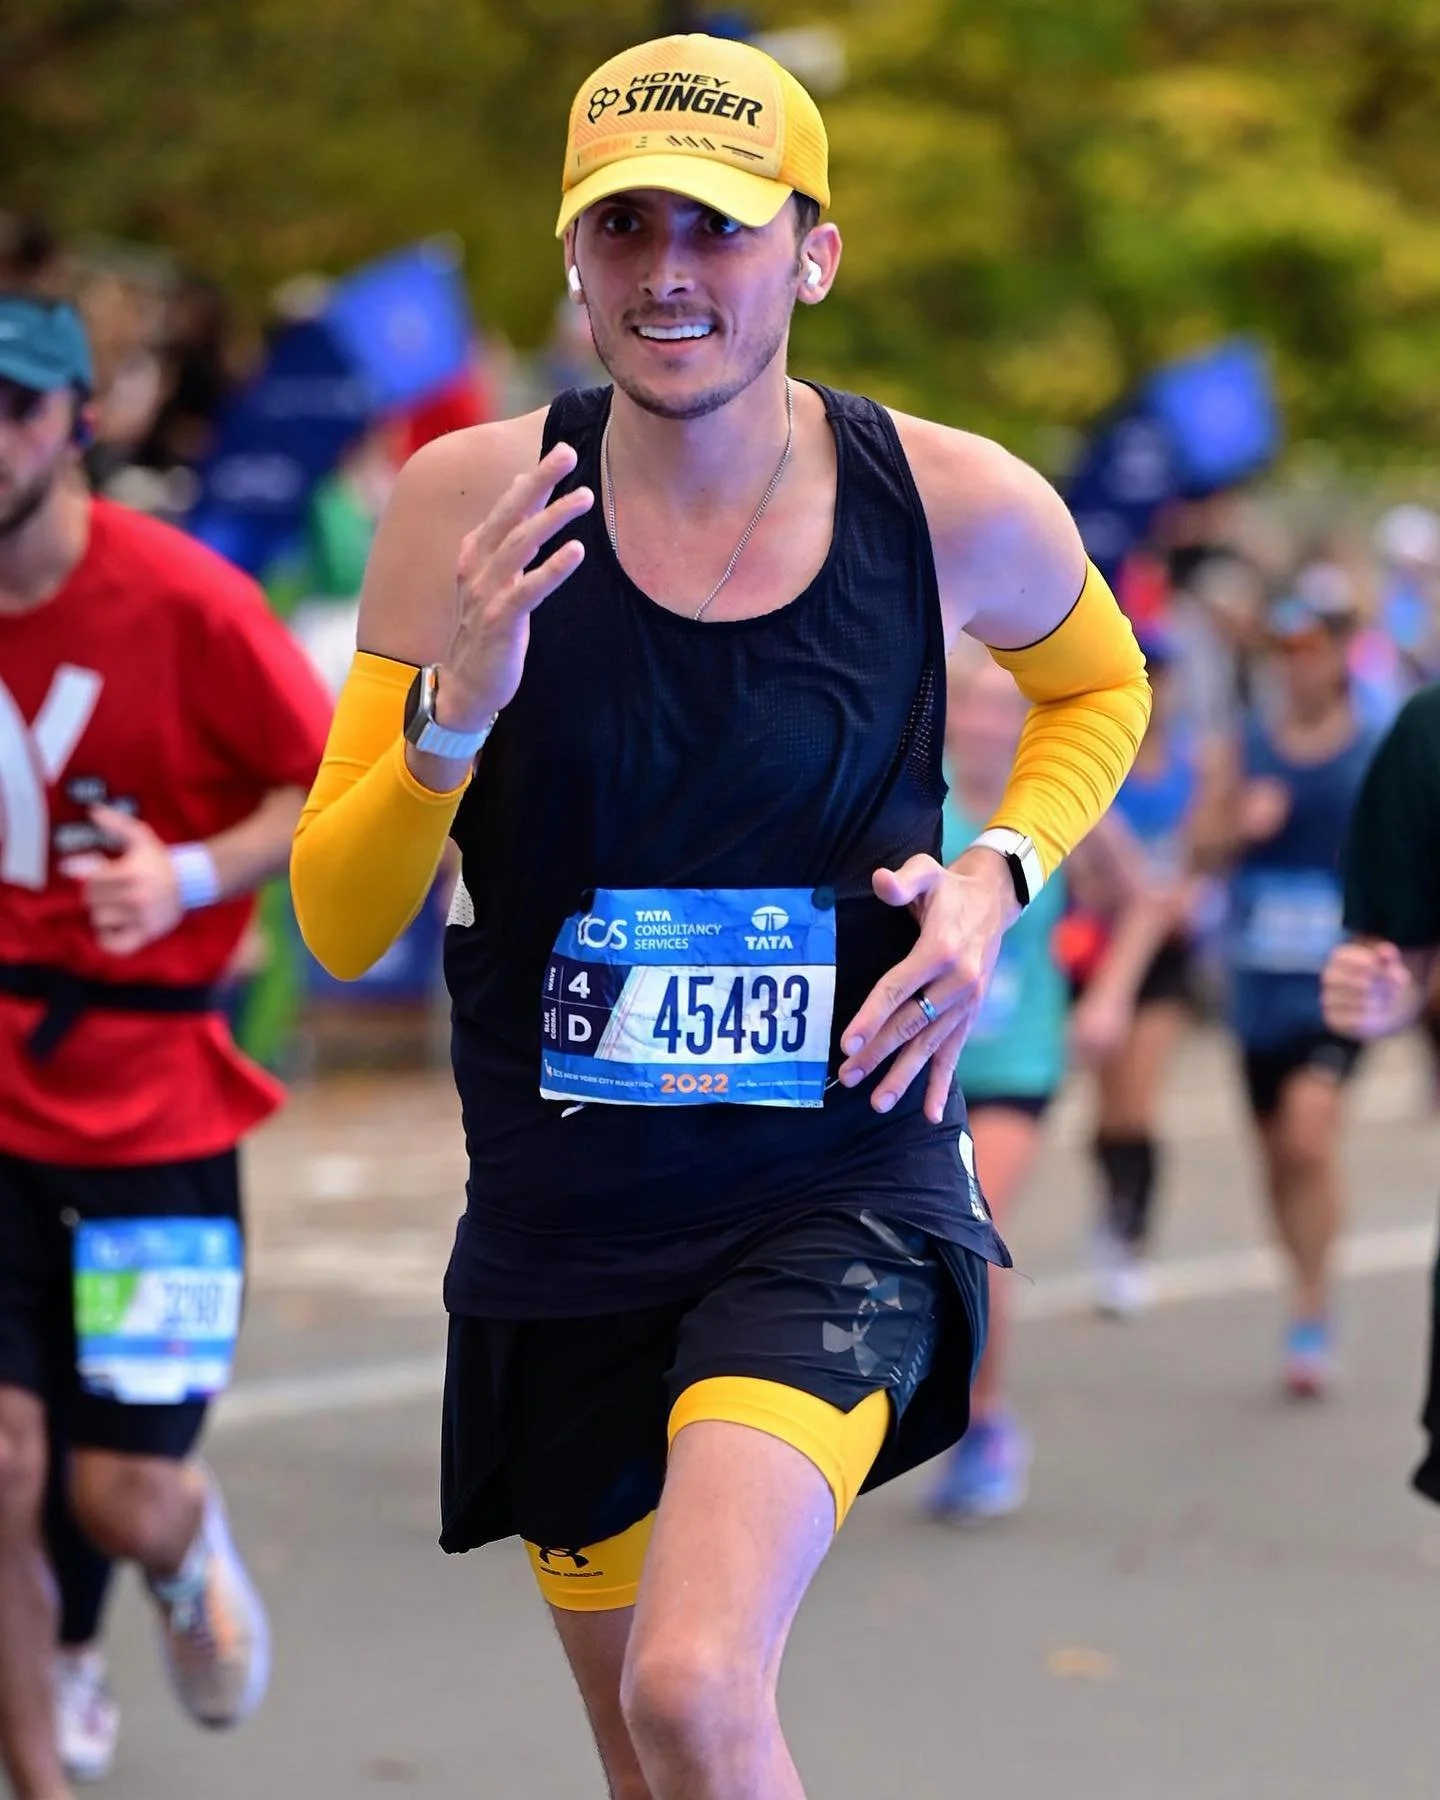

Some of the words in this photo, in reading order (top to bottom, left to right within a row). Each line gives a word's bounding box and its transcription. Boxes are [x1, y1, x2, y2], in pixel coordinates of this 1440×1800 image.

[630, 72, 731, 88] HONEY
[617, 84, 763, 127] STINGER
[635, 910, 672, 922] TATA
[634, 924, 722, 937] CONSULTANCY
[634, 938, 689, 950] SERVICES
[744, 935, 794, 950] TATA
[568, 971, 591, 999] 4
[653, 974, 810, 1055] 45433
[568, 1013, 592, 1042] D
[563, 1072, 579, 1081] NEW
[580, 1075, 598, 1083] YORK
[599, 1077, 614, 1085] CITY
[660, 1073, 729, 1094] 2022
